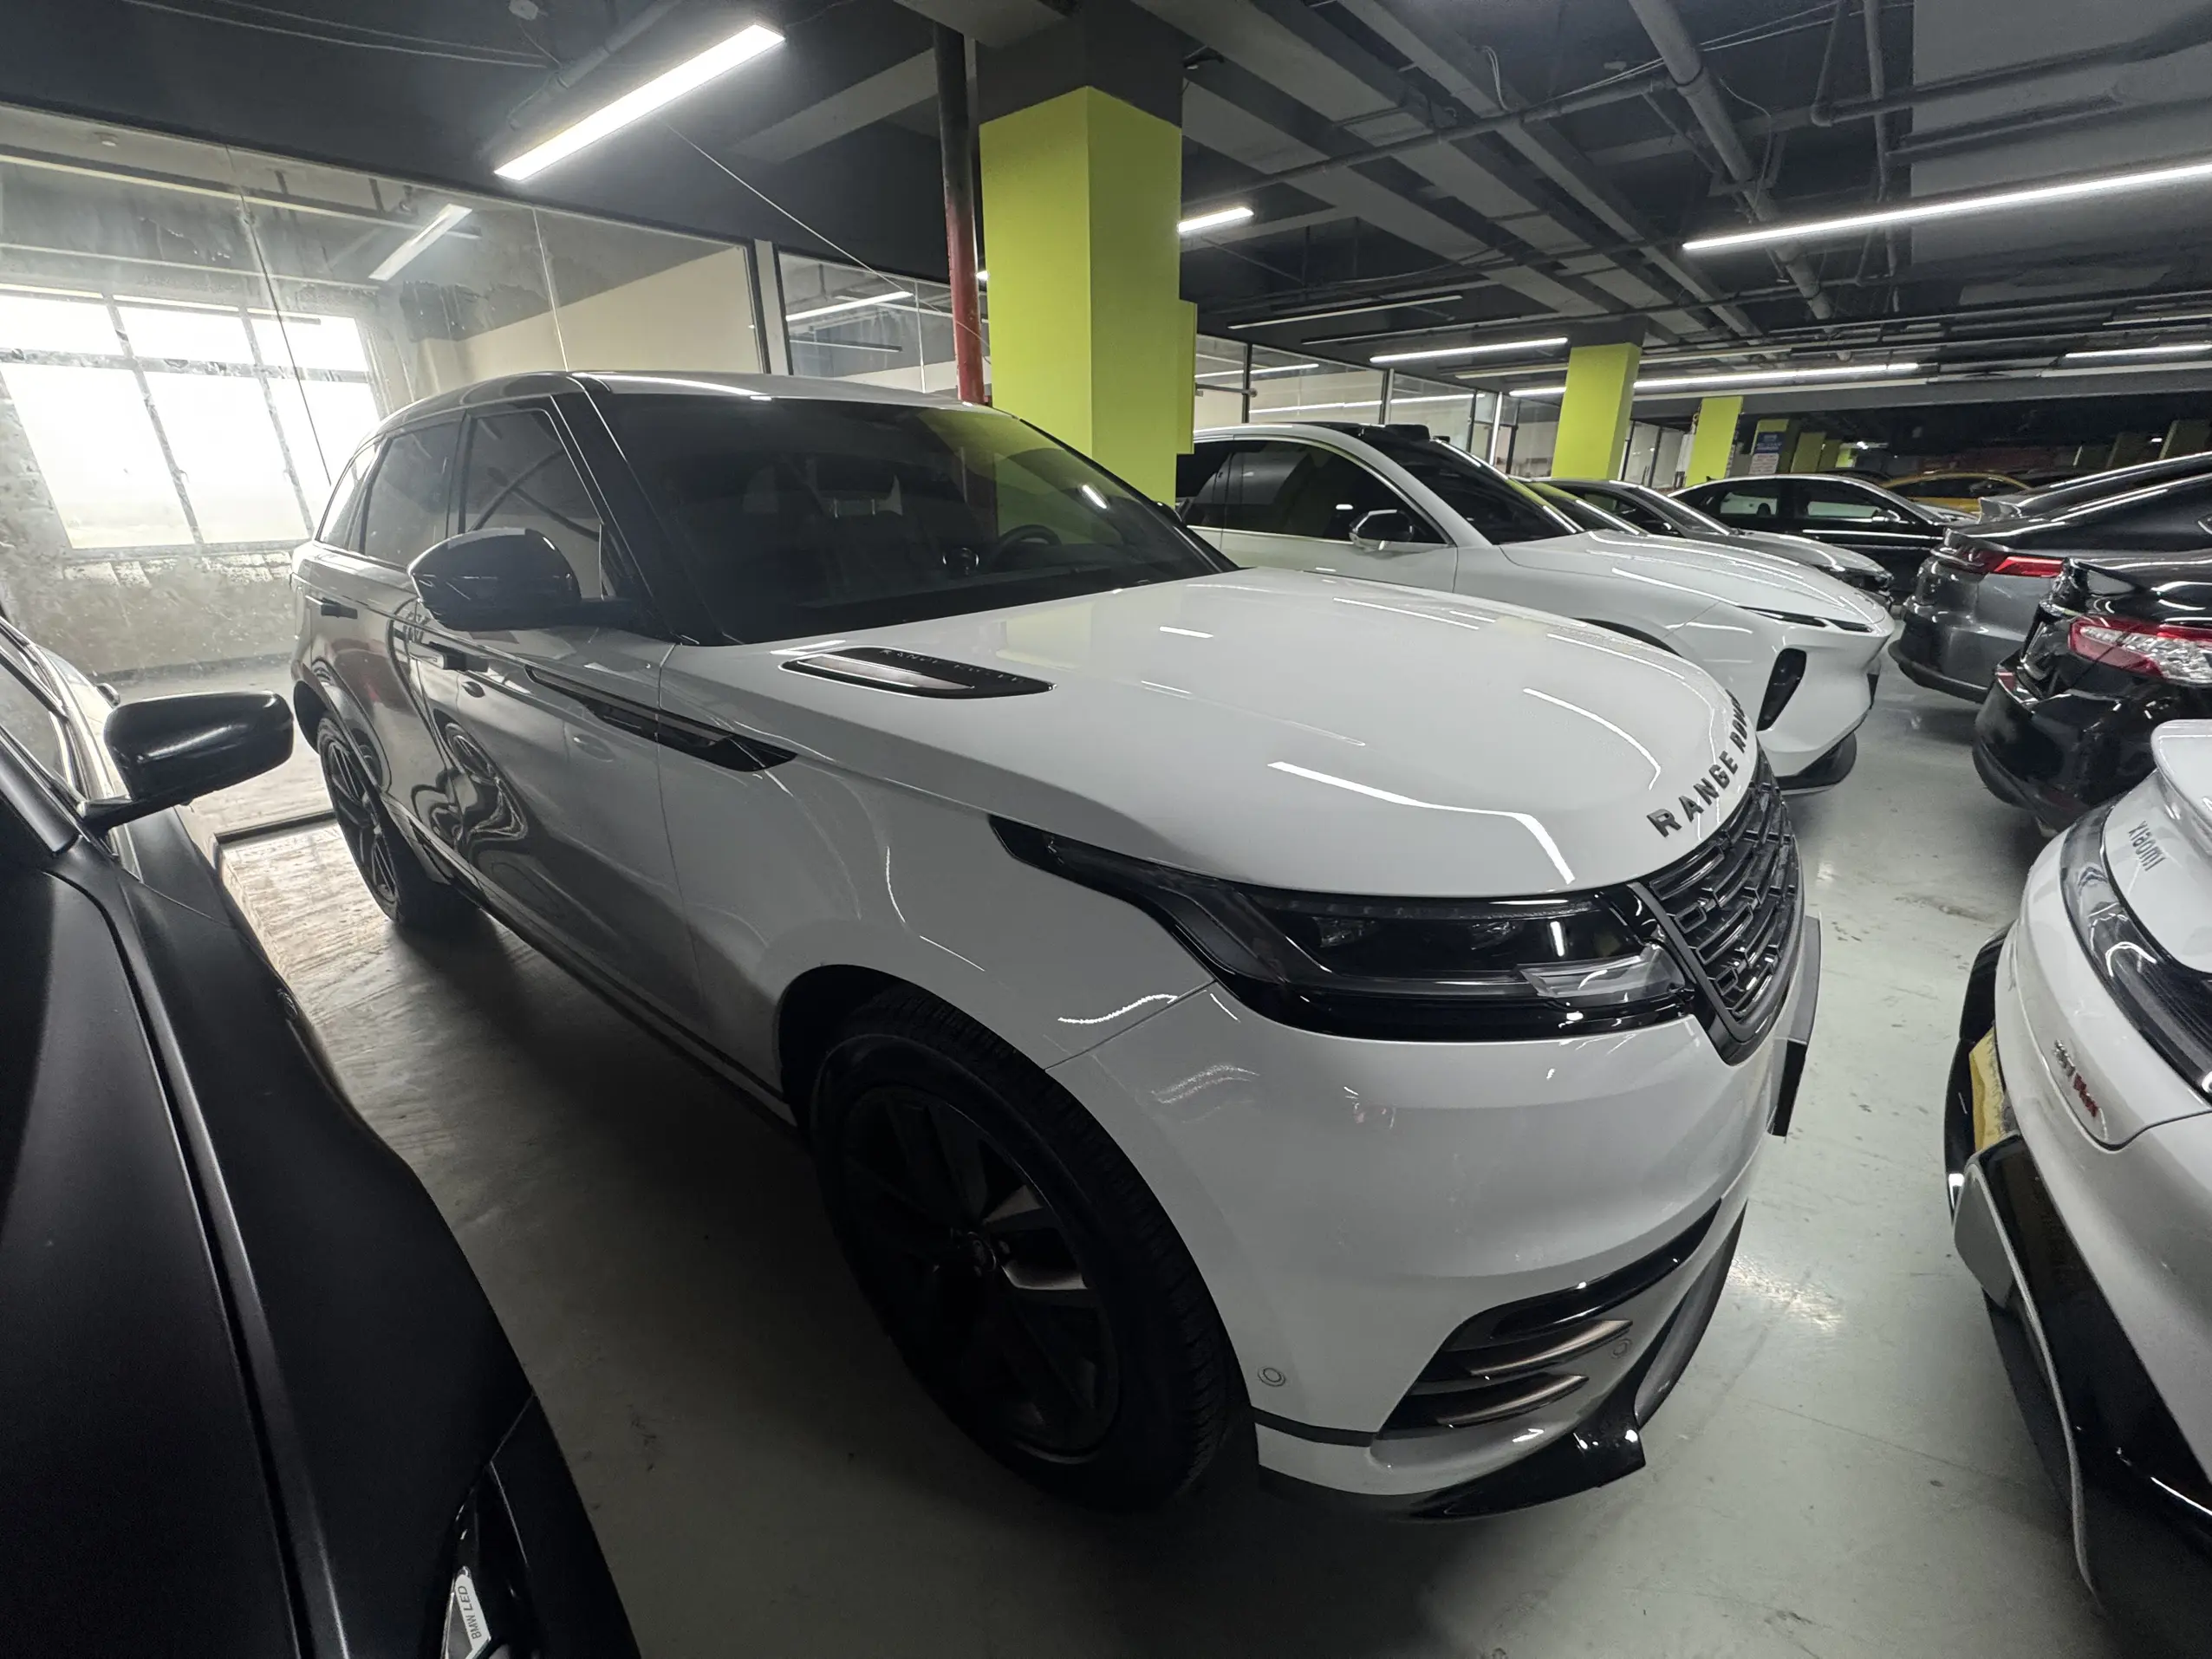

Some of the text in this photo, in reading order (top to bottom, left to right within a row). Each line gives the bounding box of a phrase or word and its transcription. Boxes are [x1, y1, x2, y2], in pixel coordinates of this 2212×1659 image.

[1647, 688, 1747, 838] RANGE ROV
[457, 1585, 482, 1640] BMW LED
